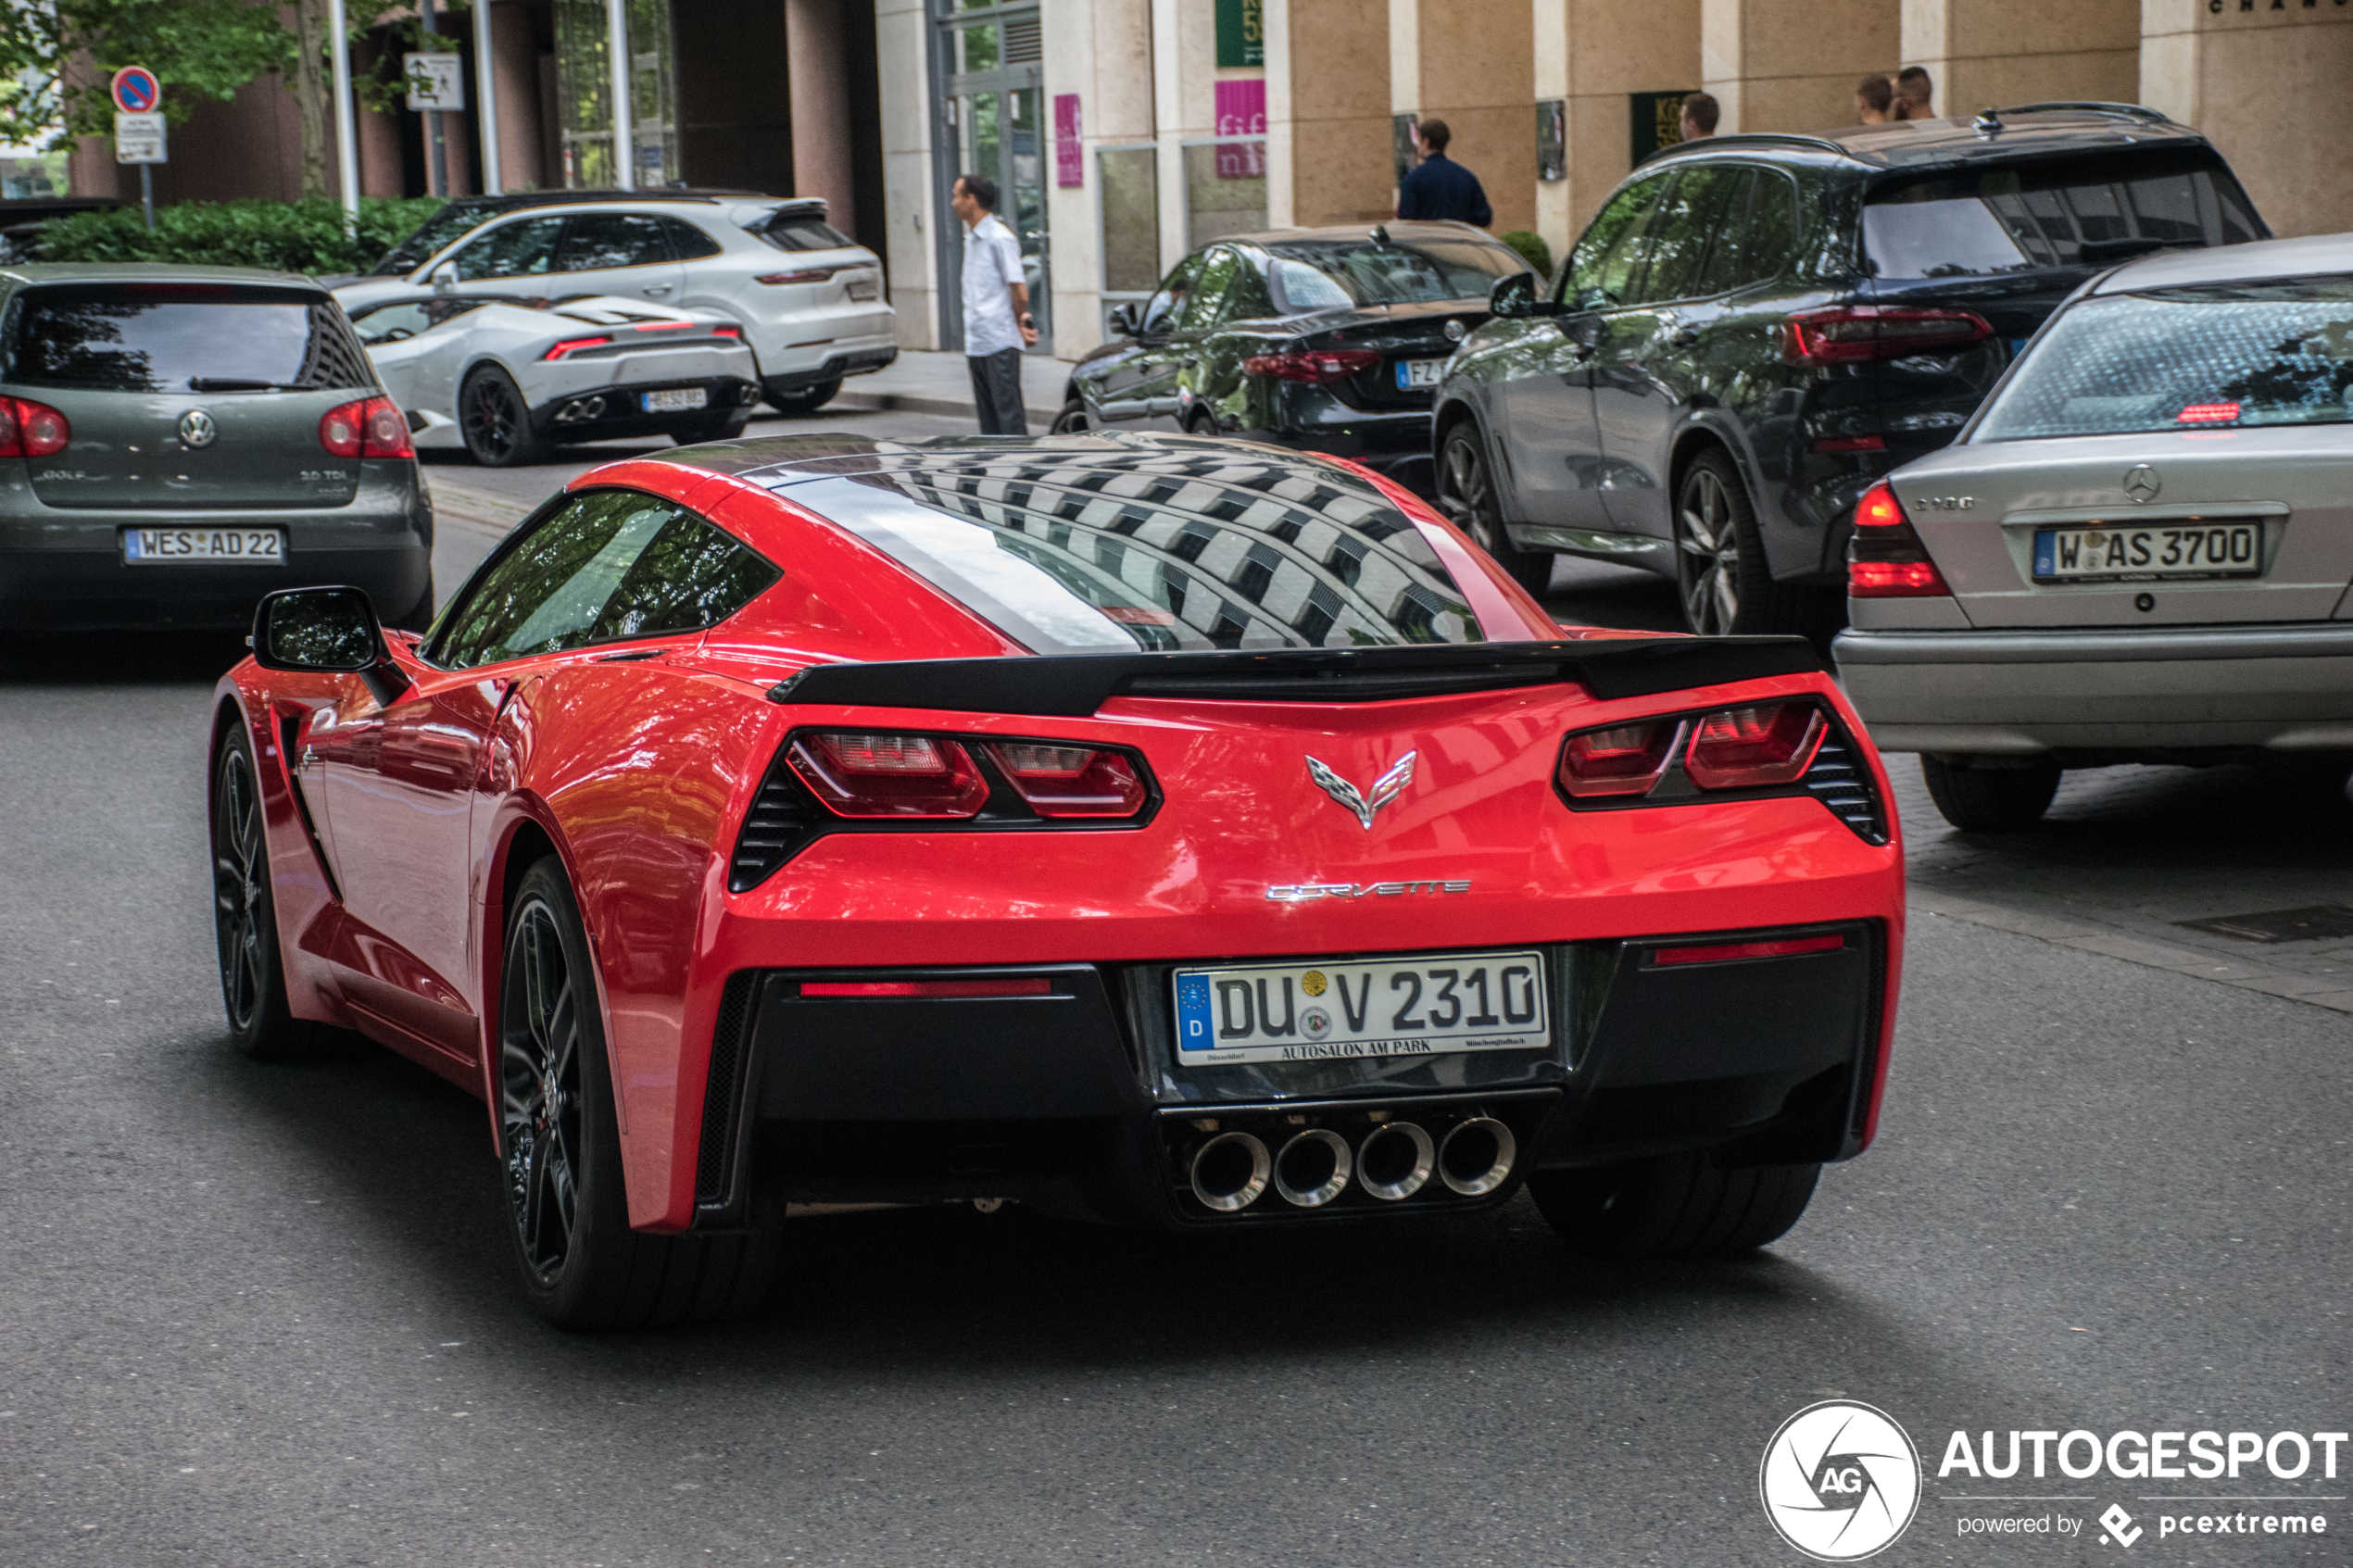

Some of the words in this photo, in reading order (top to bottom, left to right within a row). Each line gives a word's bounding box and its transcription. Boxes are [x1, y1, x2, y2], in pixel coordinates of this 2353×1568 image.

[1411, 362, 1433, 383] FZ
[142, 533, 193, 556] WES
[210, 532, 243, 556] AD
[247, 532, 279, 555] 22
[2058, 533, 2081, 569] W
[2106, 532, 2152, 568] AS
[2160, 528, 2252, 566] 3700
[1265, 880, 1472, 901] CORVETTE
[1189, 1020, 1202, 1036] D
[1215, 977, 1296, 1040] DU
[1336, 972, 1371, 1033] V
[1390, 965, 1534, 1031] 2310
[1281, 1043, 1365, 1060] AUTOSALON
[1367, 1040, 1390, 1055] AM
[1393, 1038, 1432, 1054] PARK
